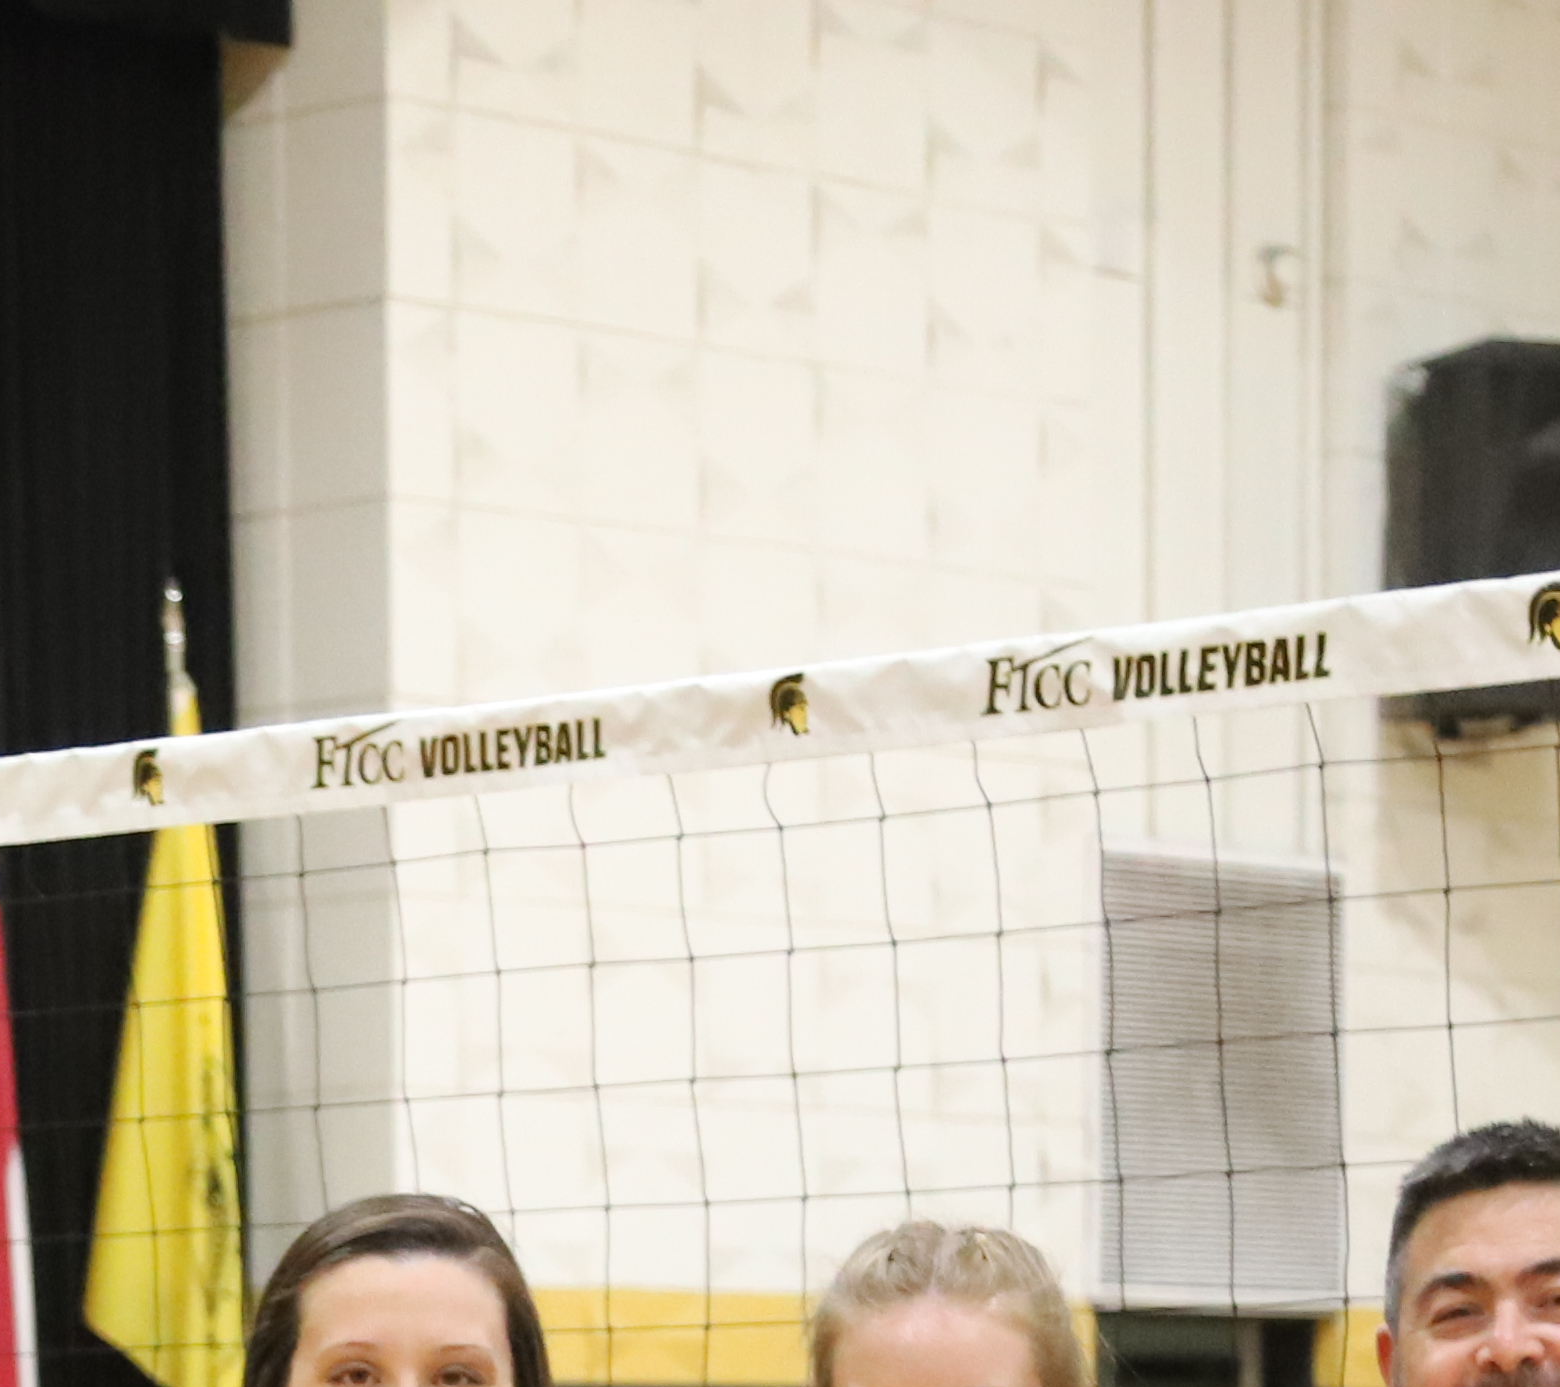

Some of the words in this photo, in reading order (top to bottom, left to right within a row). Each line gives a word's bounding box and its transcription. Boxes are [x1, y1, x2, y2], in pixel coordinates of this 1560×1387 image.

[982, 638, 1092, 716] FTCC
[1112, 632, 1331, 699] VOLLEYBALL
[310, 720, 406, 789] FTCC
[419, 717, 605, 779] VOLLEYBALL
